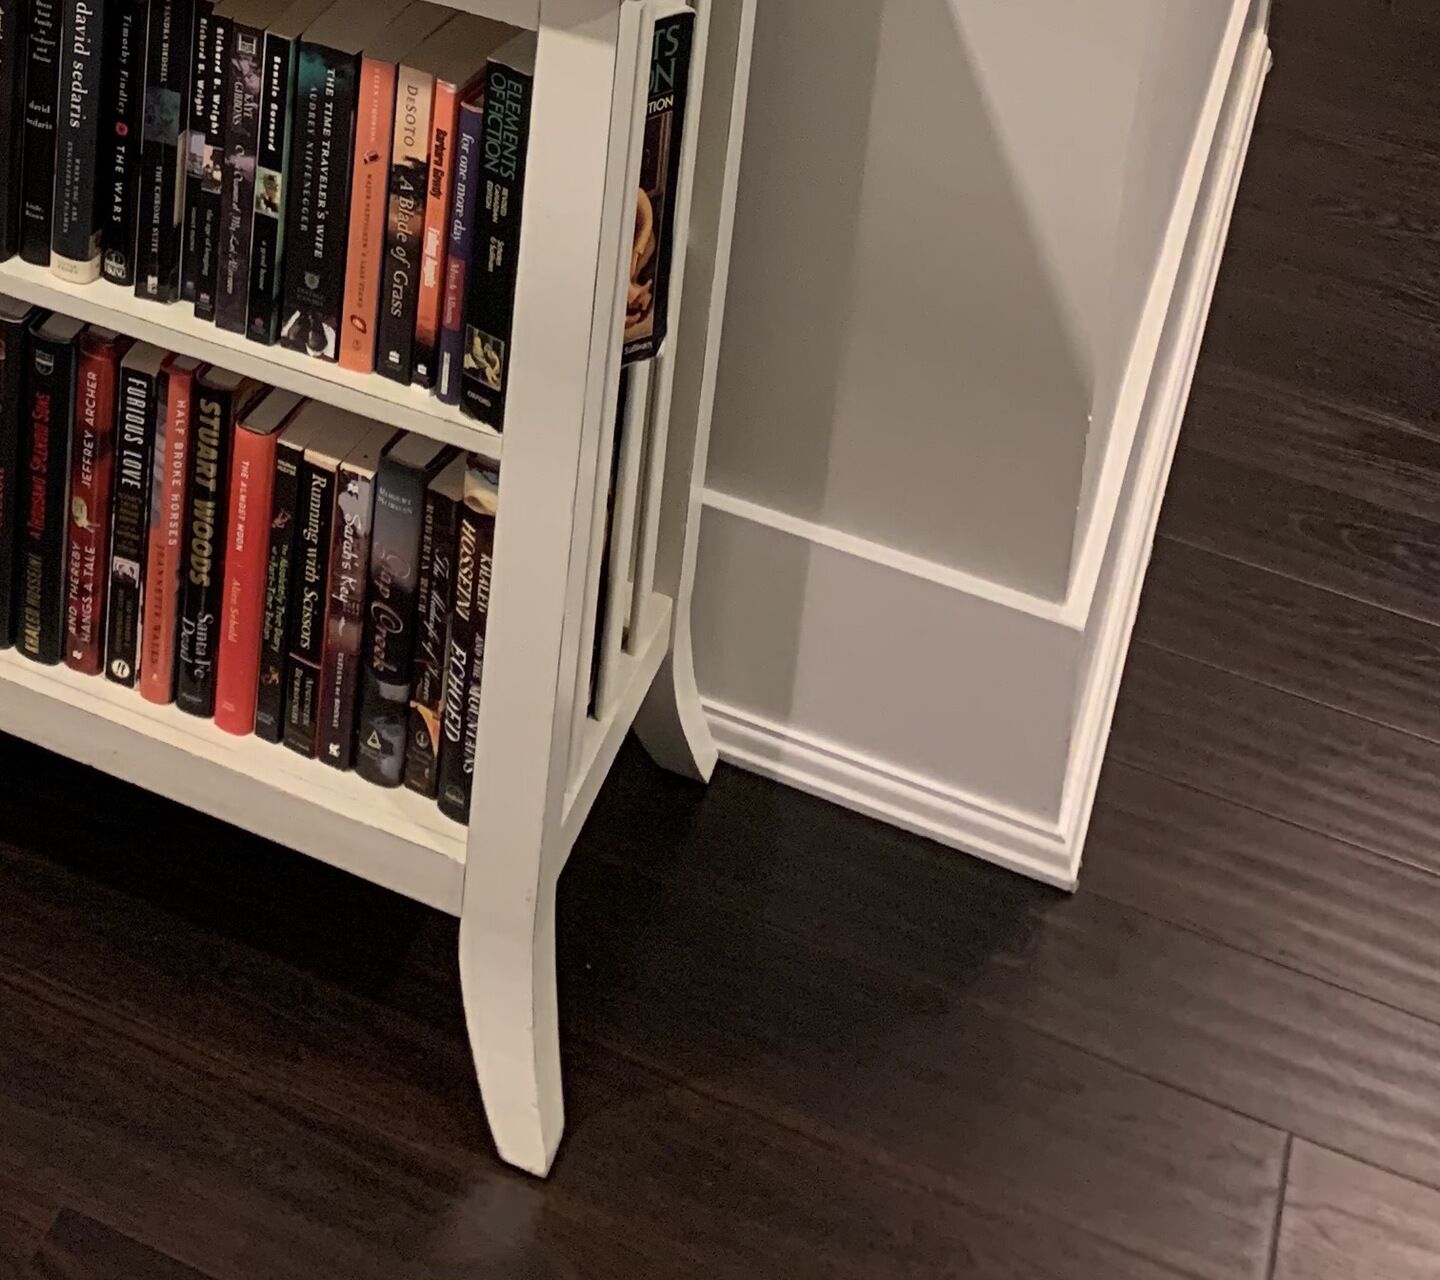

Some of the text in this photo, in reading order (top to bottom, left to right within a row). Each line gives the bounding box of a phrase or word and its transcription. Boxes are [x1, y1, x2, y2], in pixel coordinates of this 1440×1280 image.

[69, 1, 94, 129] david sedaris
[116, 13, 133, 116] Timothy Findley
[210, 93, 221, 135] Wright
[232, 80, 244, 126] GIBBONS
[300, 86, 318, 233] AUDREY NIFFENEGGER
[313, 68, 336, 259] THE TIME TRAVELER'S WIFE
[429, 127, 448, 200] Barbara Gowdy
[484, 72, 507, 174] OF FICTION
[499, 79, 523, 182] ELEMENTS
[112, 144, 126, 223] THE WARS
[451, 132, 475, 245] for one more day
[390, 175, 415, 318] A Blade of Grass
[81, 371, 98, 489] JEFFREY ARCHER
[123, 377, 147, 445] FURIOUS
[121, 449, 143, 490] LOVE
[168, 399, 187, 547] HALF BROKE HORSES
[189, 398, 222, 587] STUART WOODS
[235, 460, 250, 552] THE ALMOST MOON
[24, 552, 42, 655] KHALED HOSSEINI
[68, 541, 81, 636] AND THEREBY
[80, 545, 96, 643] HANGS A TALE
[300, 473, 328, 650] Running with Scissors
[331, 512, 362, 604] Sarah's Key
[418, 577, 430, 613] RICH
[455, 518, 477, 623] HOSSEINI
[180, 616, 196, 664] Dead
[194, 611, 215, 680] Santa Fe
[370, 601, 404, 673] Creek
[445, 640, 468, 743] ECHOED
[462, 632, 484, 774] AND THE MOUNTAINS
